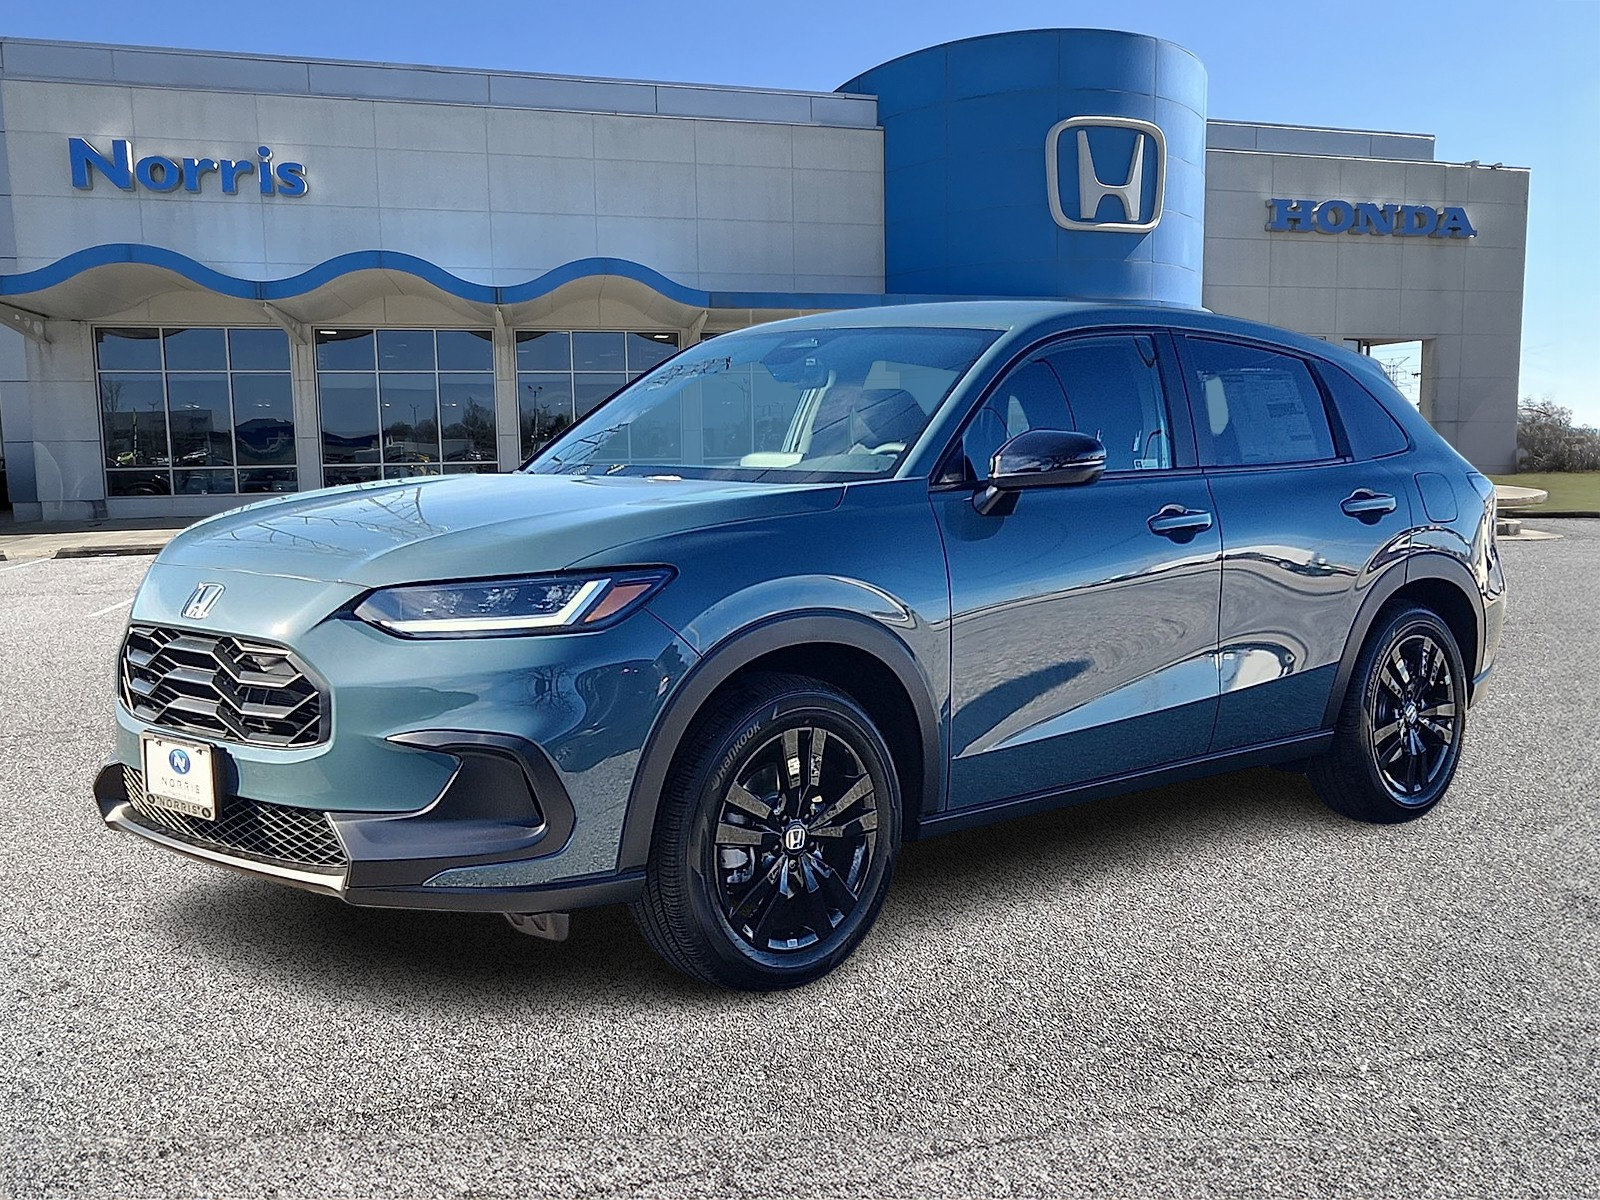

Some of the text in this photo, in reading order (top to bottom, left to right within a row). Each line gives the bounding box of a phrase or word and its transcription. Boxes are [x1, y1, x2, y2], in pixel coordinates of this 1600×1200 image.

[68, 137, 308, 197] Norris
[1265, 198, 1478, 238] HONDA
[160, 797, 199, 815] NORRIS
